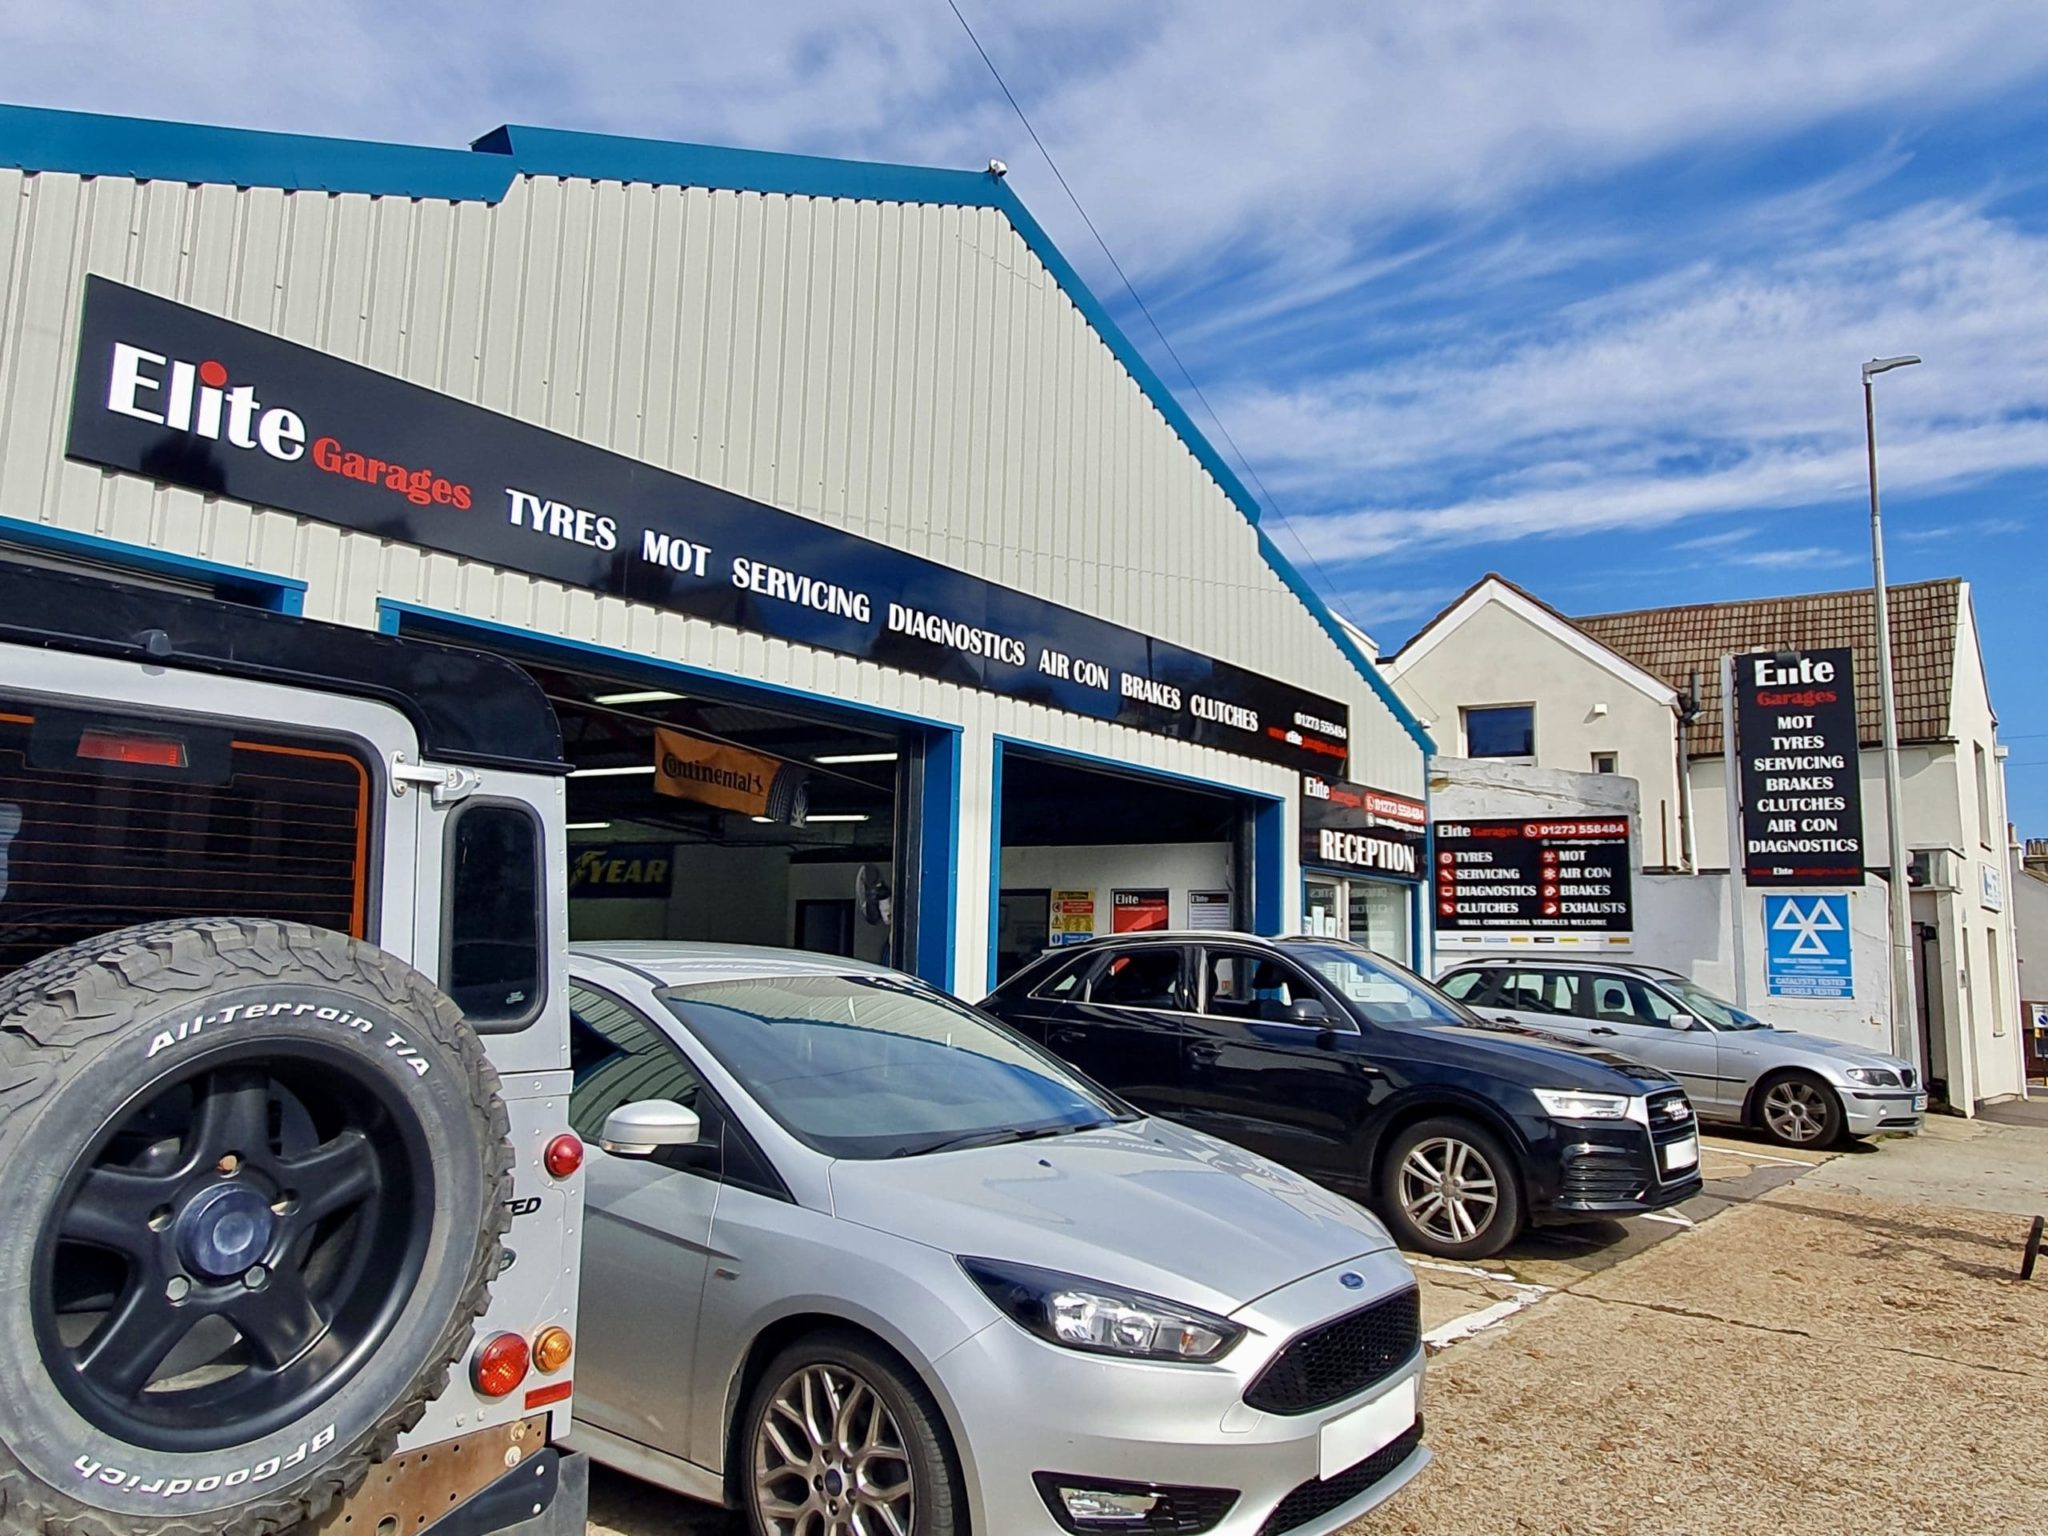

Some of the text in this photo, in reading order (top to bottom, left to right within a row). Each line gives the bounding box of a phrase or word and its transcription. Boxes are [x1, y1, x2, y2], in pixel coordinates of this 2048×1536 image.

[106, 341, 472, 511] Elite Garages
[505, 488, 1259, 732] TYRES MOT SERVICING DIAGNOSTICS AIR CON BRAKES CLUTCHES
[1757, 691, 1837, 707] Garages
[1777, 715, 1815, 729] MOT
[1771, 735, 1825, 750] TYRES
[1754, 755, 1844, 772] SERVICING
[662, 751, 752, 793] Continental
[1304, 776, 1330, 800] Elite
[1766, 776, 1834, 792] BRAKES
[1757, 796, 1846, 812] CLUTCHES
[1437, 824, 1471, 838] Elite
[1540, 824, 1576, 835] 01273
[1578, 823, 1625, 835] 558484
[1767, 818, 1838, 833] AIR CON
[1320, 829, 1415, 873] RECEPTION
[1748, 838, 1858, 853] DIAGNOSTICS
[1455, 851, 1493, 863] TYRES
[1559, 850, 1586, 861] MOT
[1455, 868, 1520, 880] SERVICING
[1559, 867, 1611, 879] AIR CON
[1456, 885, 1537, 897] DIAGNOSTICS
[1560, 885, 1611, 896] BRAKES
[1115, 893, 1139, 905] Elite
[1456, 902, 1519, 914] CLUTCHES
[1561, 902, 1626, 914] EXHAUSTS
[147, 1003, 430, 1076] All-Terrain T/A
[74, 1423, 335, 1500] BFGoodrich
